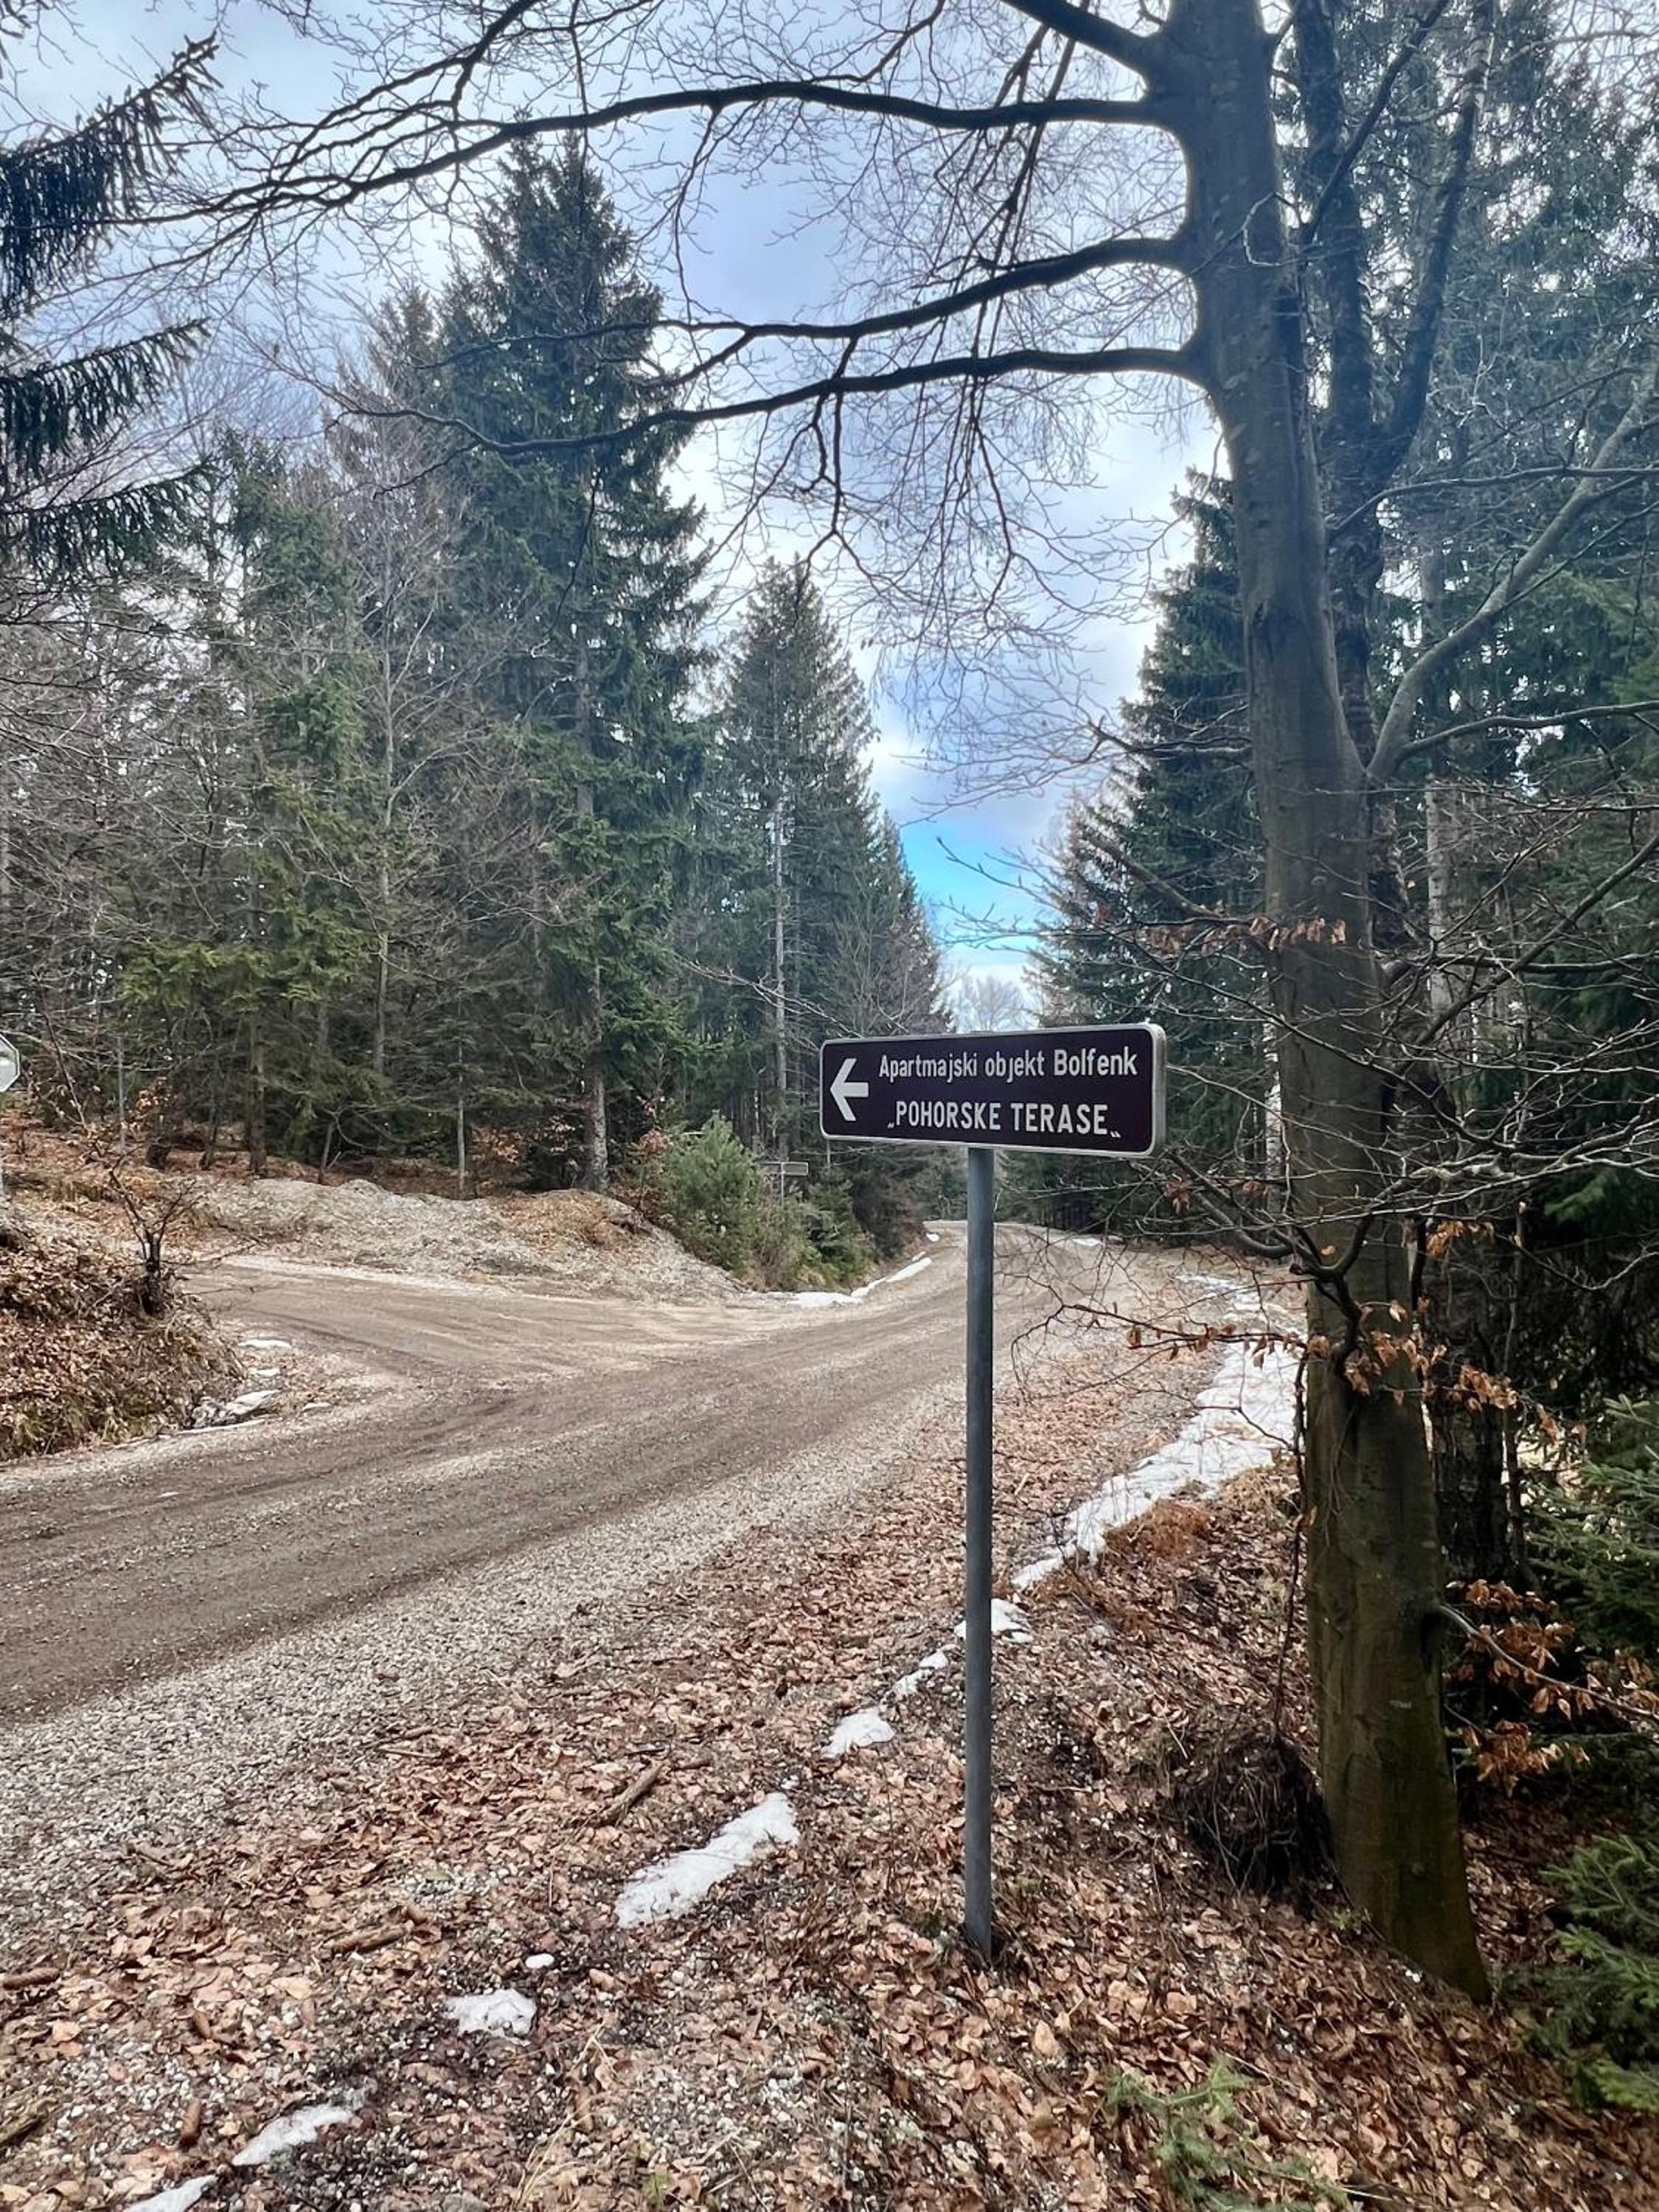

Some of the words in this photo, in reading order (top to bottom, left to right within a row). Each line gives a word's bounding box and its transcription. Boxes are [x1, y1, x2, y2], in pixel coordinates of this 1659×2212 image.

[879, 1053, 978, 1082] Apartmajski
[984, 1051, 1044, 1083] objekt
[1053, 1046, 1138, 1077] Bolfenk
